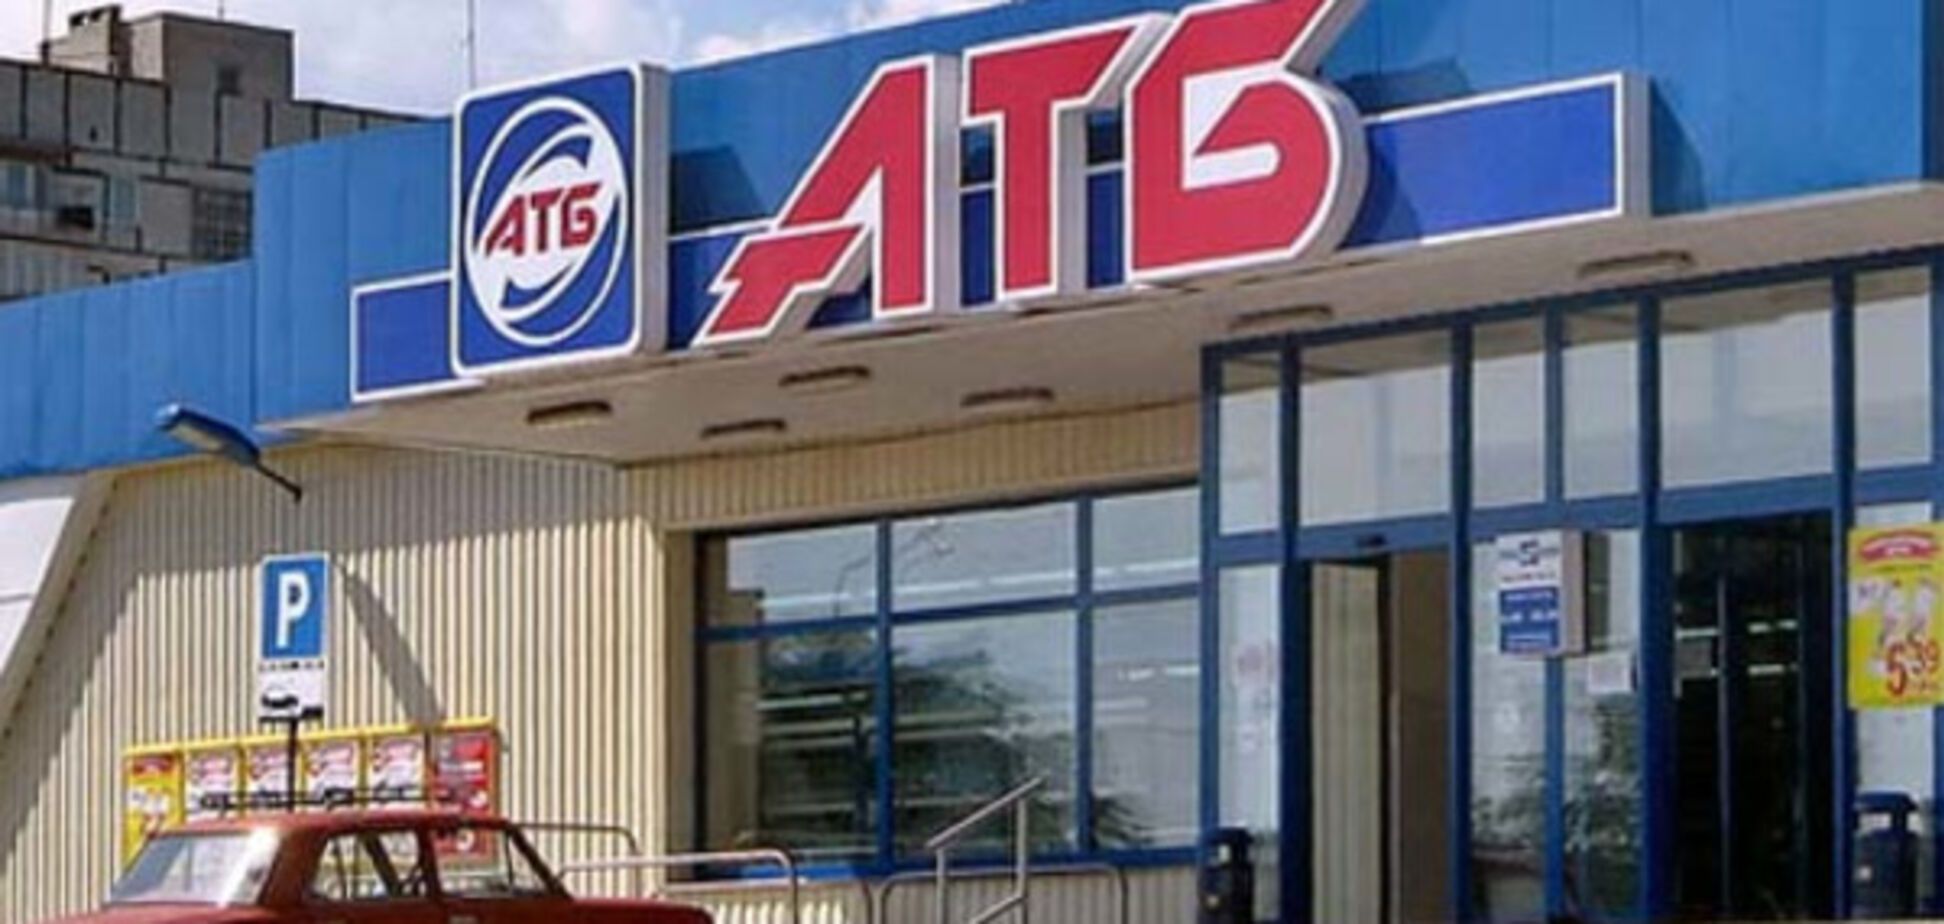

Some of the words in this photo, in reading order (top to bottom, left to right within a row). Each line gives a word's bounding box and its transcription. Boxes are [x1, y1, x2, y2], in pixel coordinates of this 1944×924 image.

[692, 0, 1346, 347] АТБ
[484, 182, 603, 258] АТБ
[276, 571, 311, 648] P
